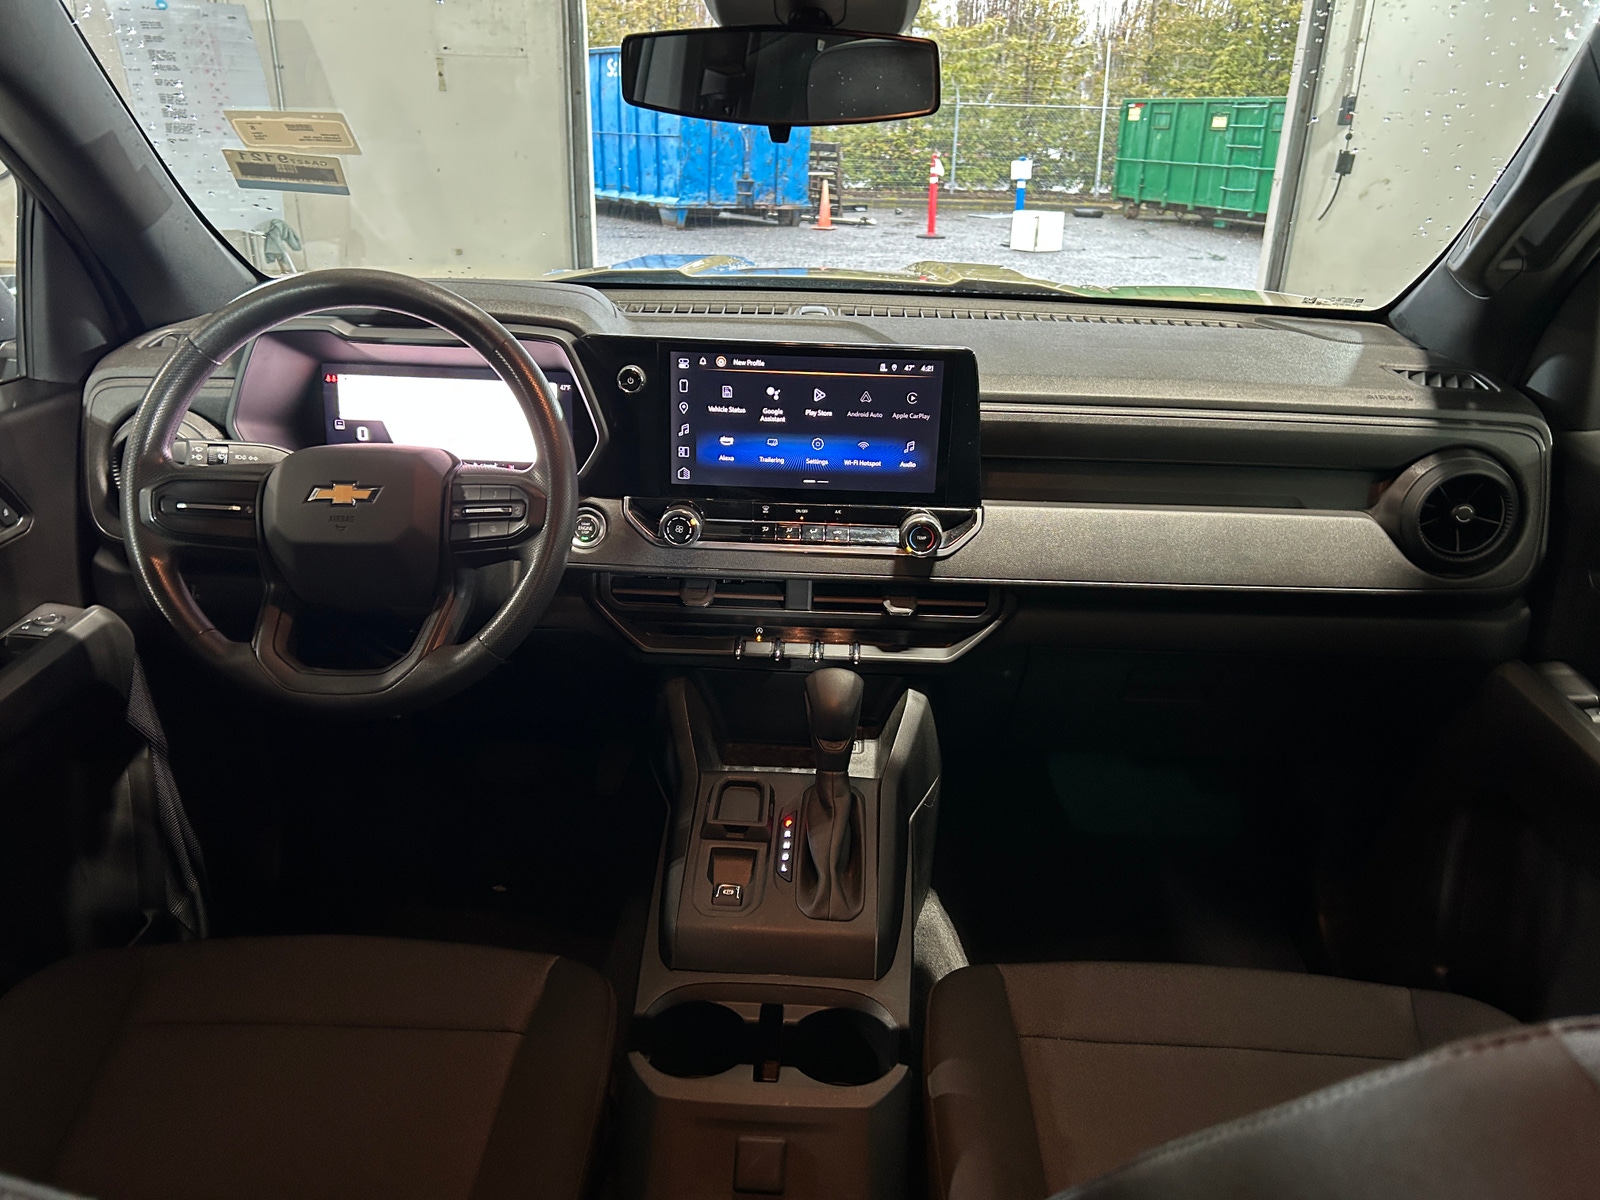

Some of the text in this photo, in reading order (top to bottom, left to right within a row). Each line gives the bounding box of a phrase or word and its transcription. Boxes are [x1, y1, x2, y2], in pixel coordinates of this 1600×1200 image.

[733, 359, 765, 368] New Profile
[708, 405, 746, 414] Vehicle Status
[762, 407, 784, 416] Google
[805, 409, 818, 417] Play
[892, 412, 931, 421] Apple CarPlay
[356, 426, 369, 441] 0
[759, 456, 785, 464] Trailering
[806, 458, 829, 466] Settings
[859, 460, 882, 468] Hotspot
